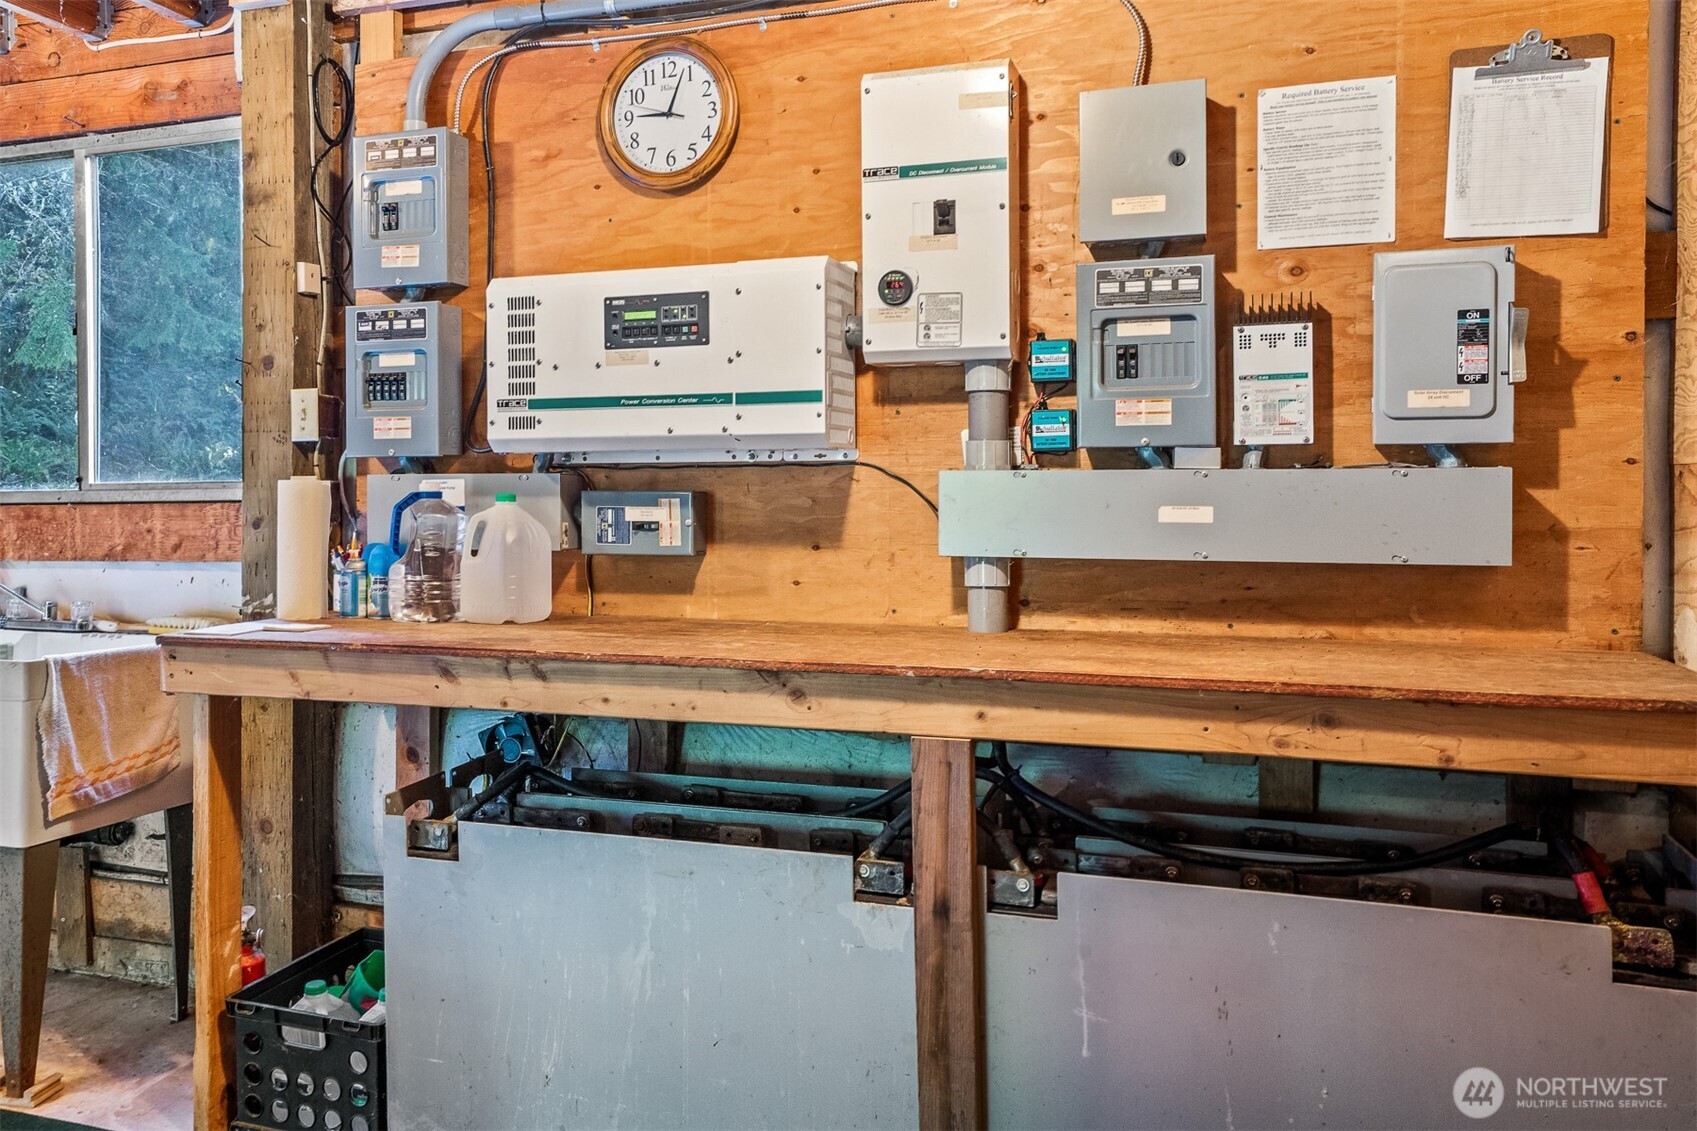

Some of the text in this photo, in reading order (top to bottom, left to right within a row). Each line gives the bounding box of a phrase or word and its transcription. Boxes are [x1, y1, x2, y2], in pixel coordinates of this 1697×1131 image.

[643, 69, 655, 87] 11
[661, 61, 678, 80] 12
[687, 65, 693, 82] 1
[1516, 75, 1539, 83] Service
[1540, 73, 1564, 81] Record
[629, 87, 645, 106] 10
[702, 80, 712, 98] 2
[1281, 84, 1366, 100] Required Battery Service
[624, 110, 634, 128] 9
[707, 101, 718, 119] 3
[630, 132, 640, 150] 8
[701, 125, 712, 142] 4
[647, 147, 656, 165] 7
[666, 149, 676, 167] 6
[687, 142, 698, 161] 5
[918, 168, 944, 176] Disconnect
[978, 163, 997, 171] Module
[1463, 374, 1482, 382] OFF
